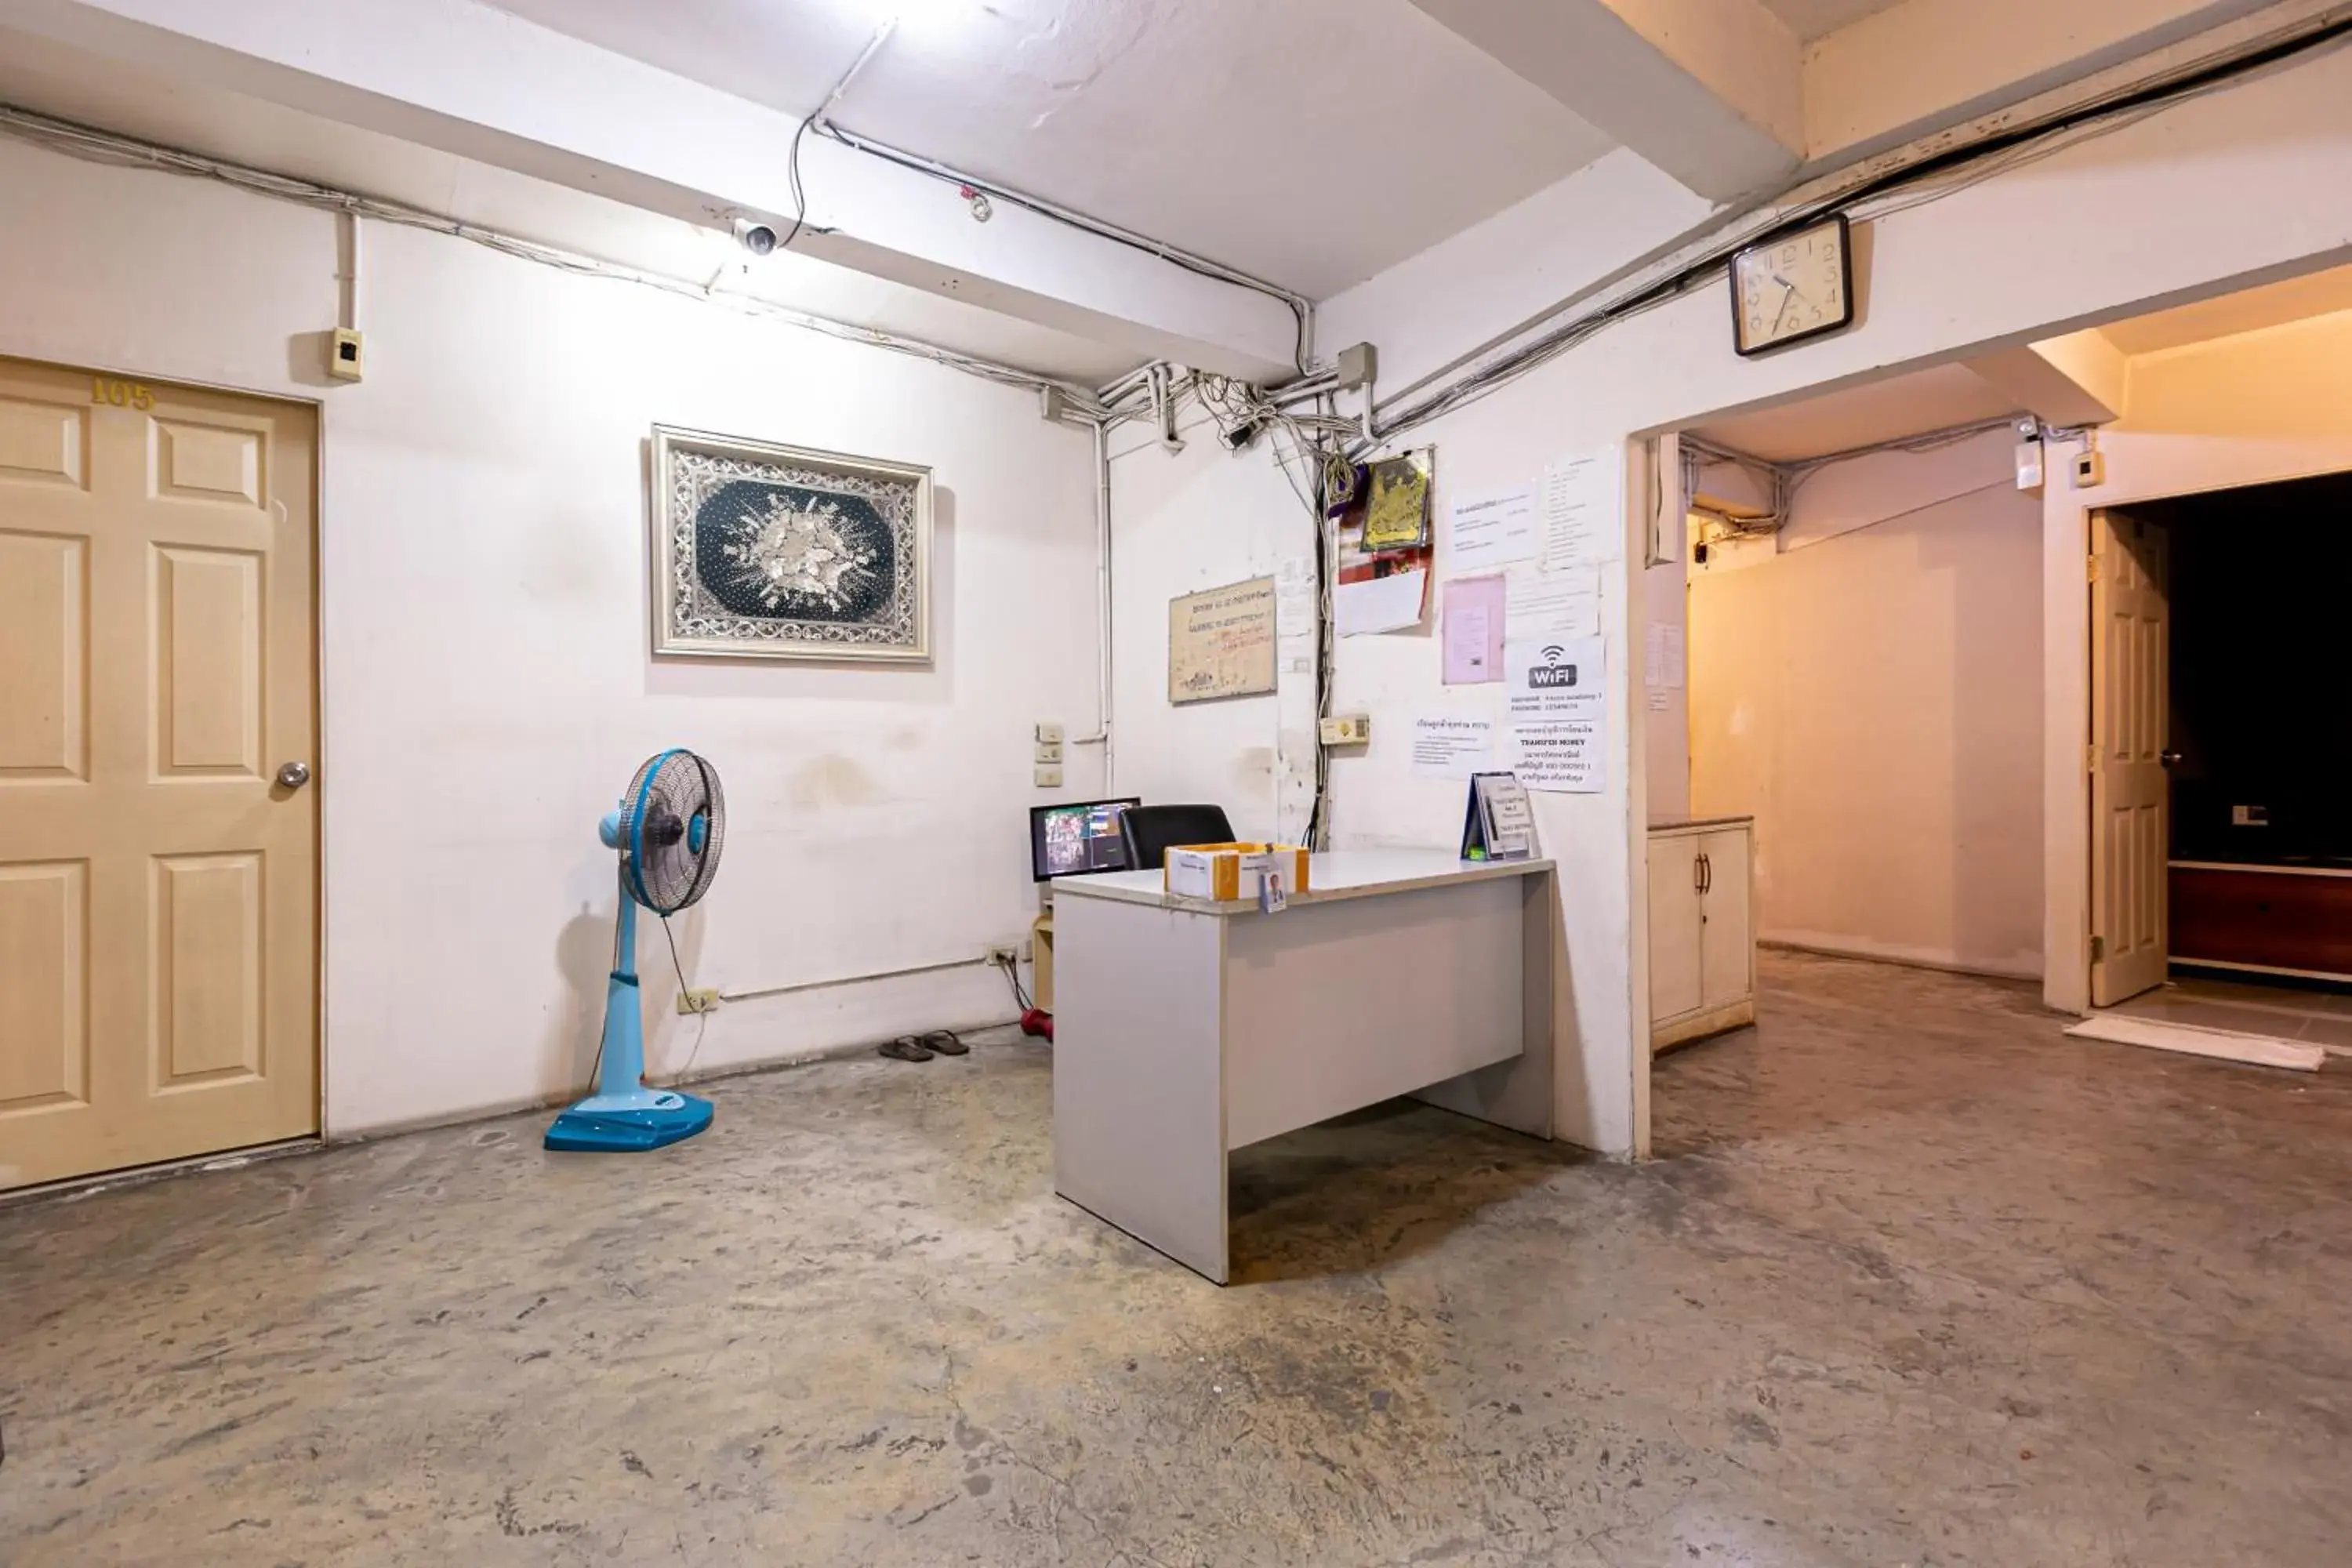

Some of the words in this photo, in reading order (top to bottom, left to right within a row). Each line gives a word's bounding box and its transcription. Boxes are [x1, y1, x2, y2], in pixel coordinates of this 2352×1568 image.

[1823, 245, 1835, 261] 2
[1826, 288, 1836, 304] 4
[91, 375, 155, 412] 105
